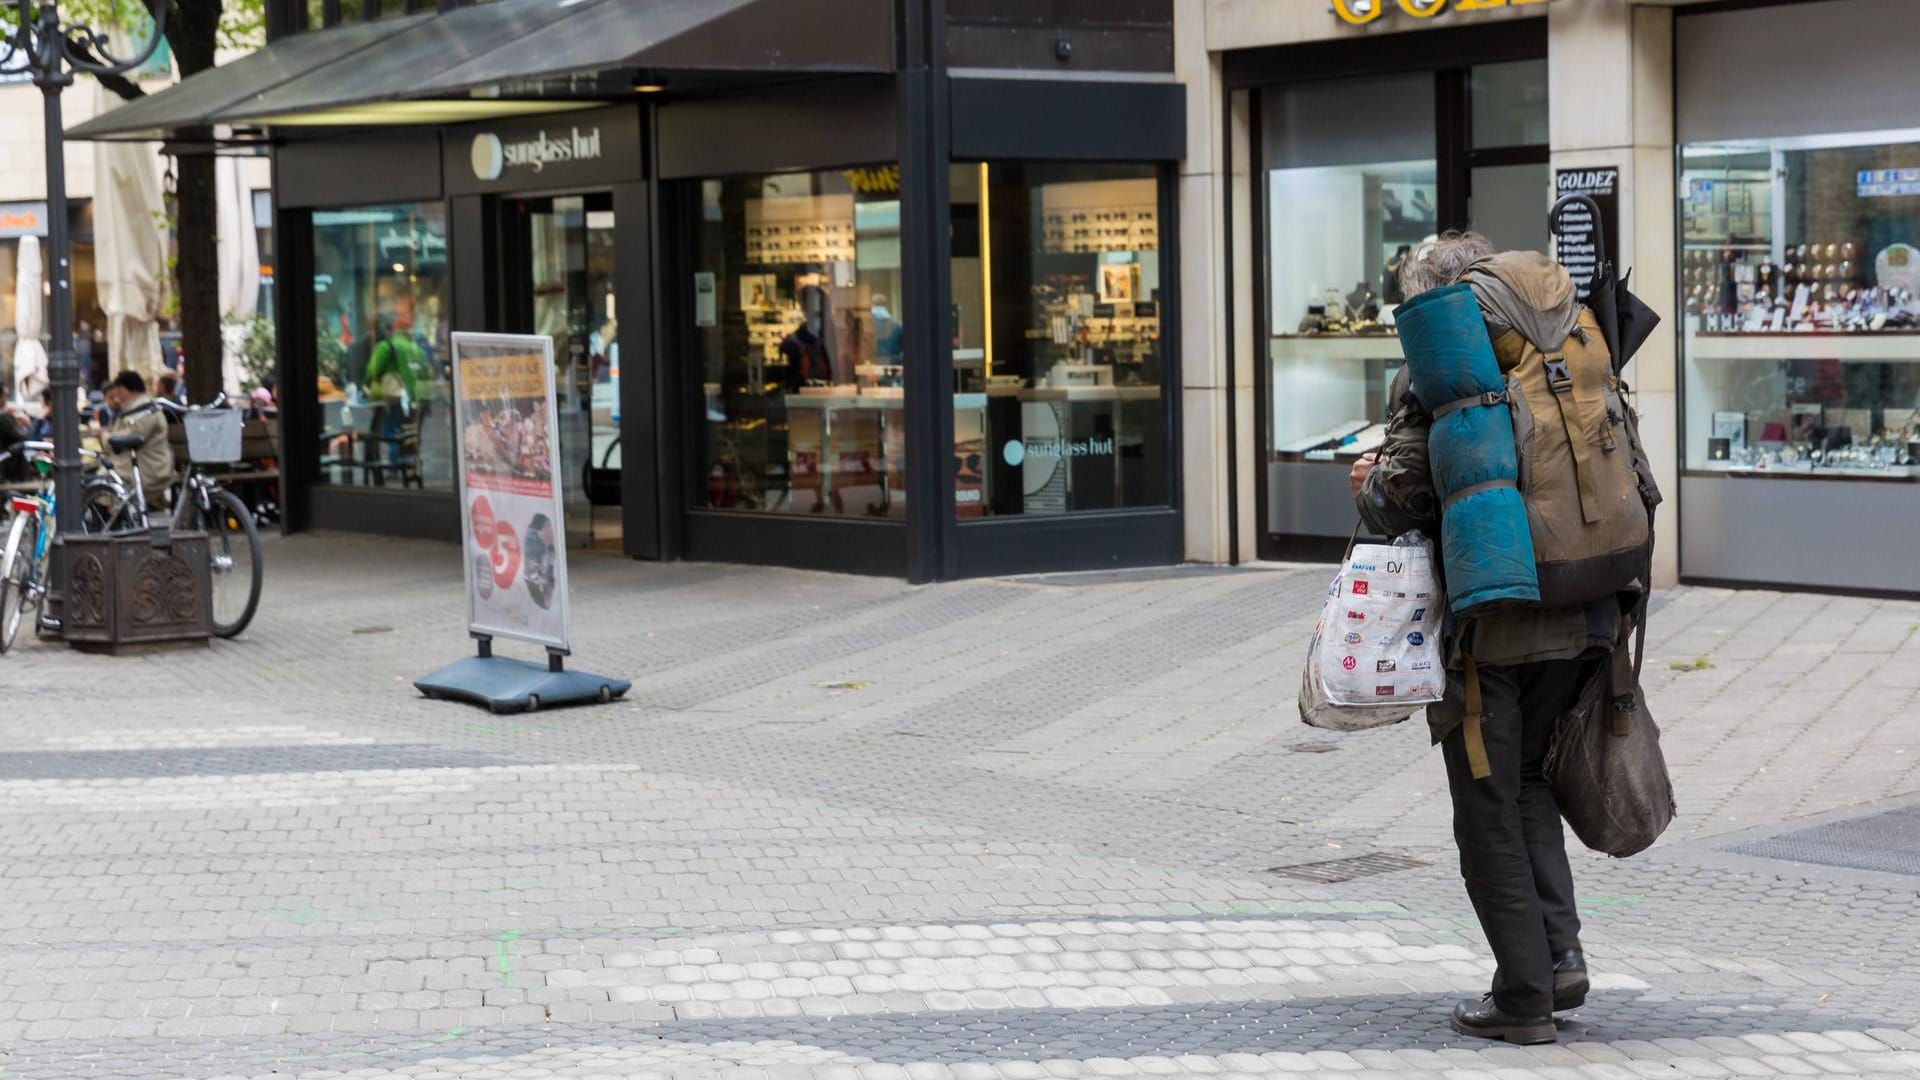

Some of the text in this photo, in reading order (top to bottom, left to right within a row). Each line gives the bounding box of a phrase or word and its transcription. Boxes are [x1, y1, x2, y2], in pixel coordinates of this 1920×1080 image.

[504, 127, 601, 172] sunglass hut
[1557, 170, 1617, 189] GOLDEZ
[1027, 437, 1113, 458] sunglass hut
[1387, 561, 1402, 574] CV
